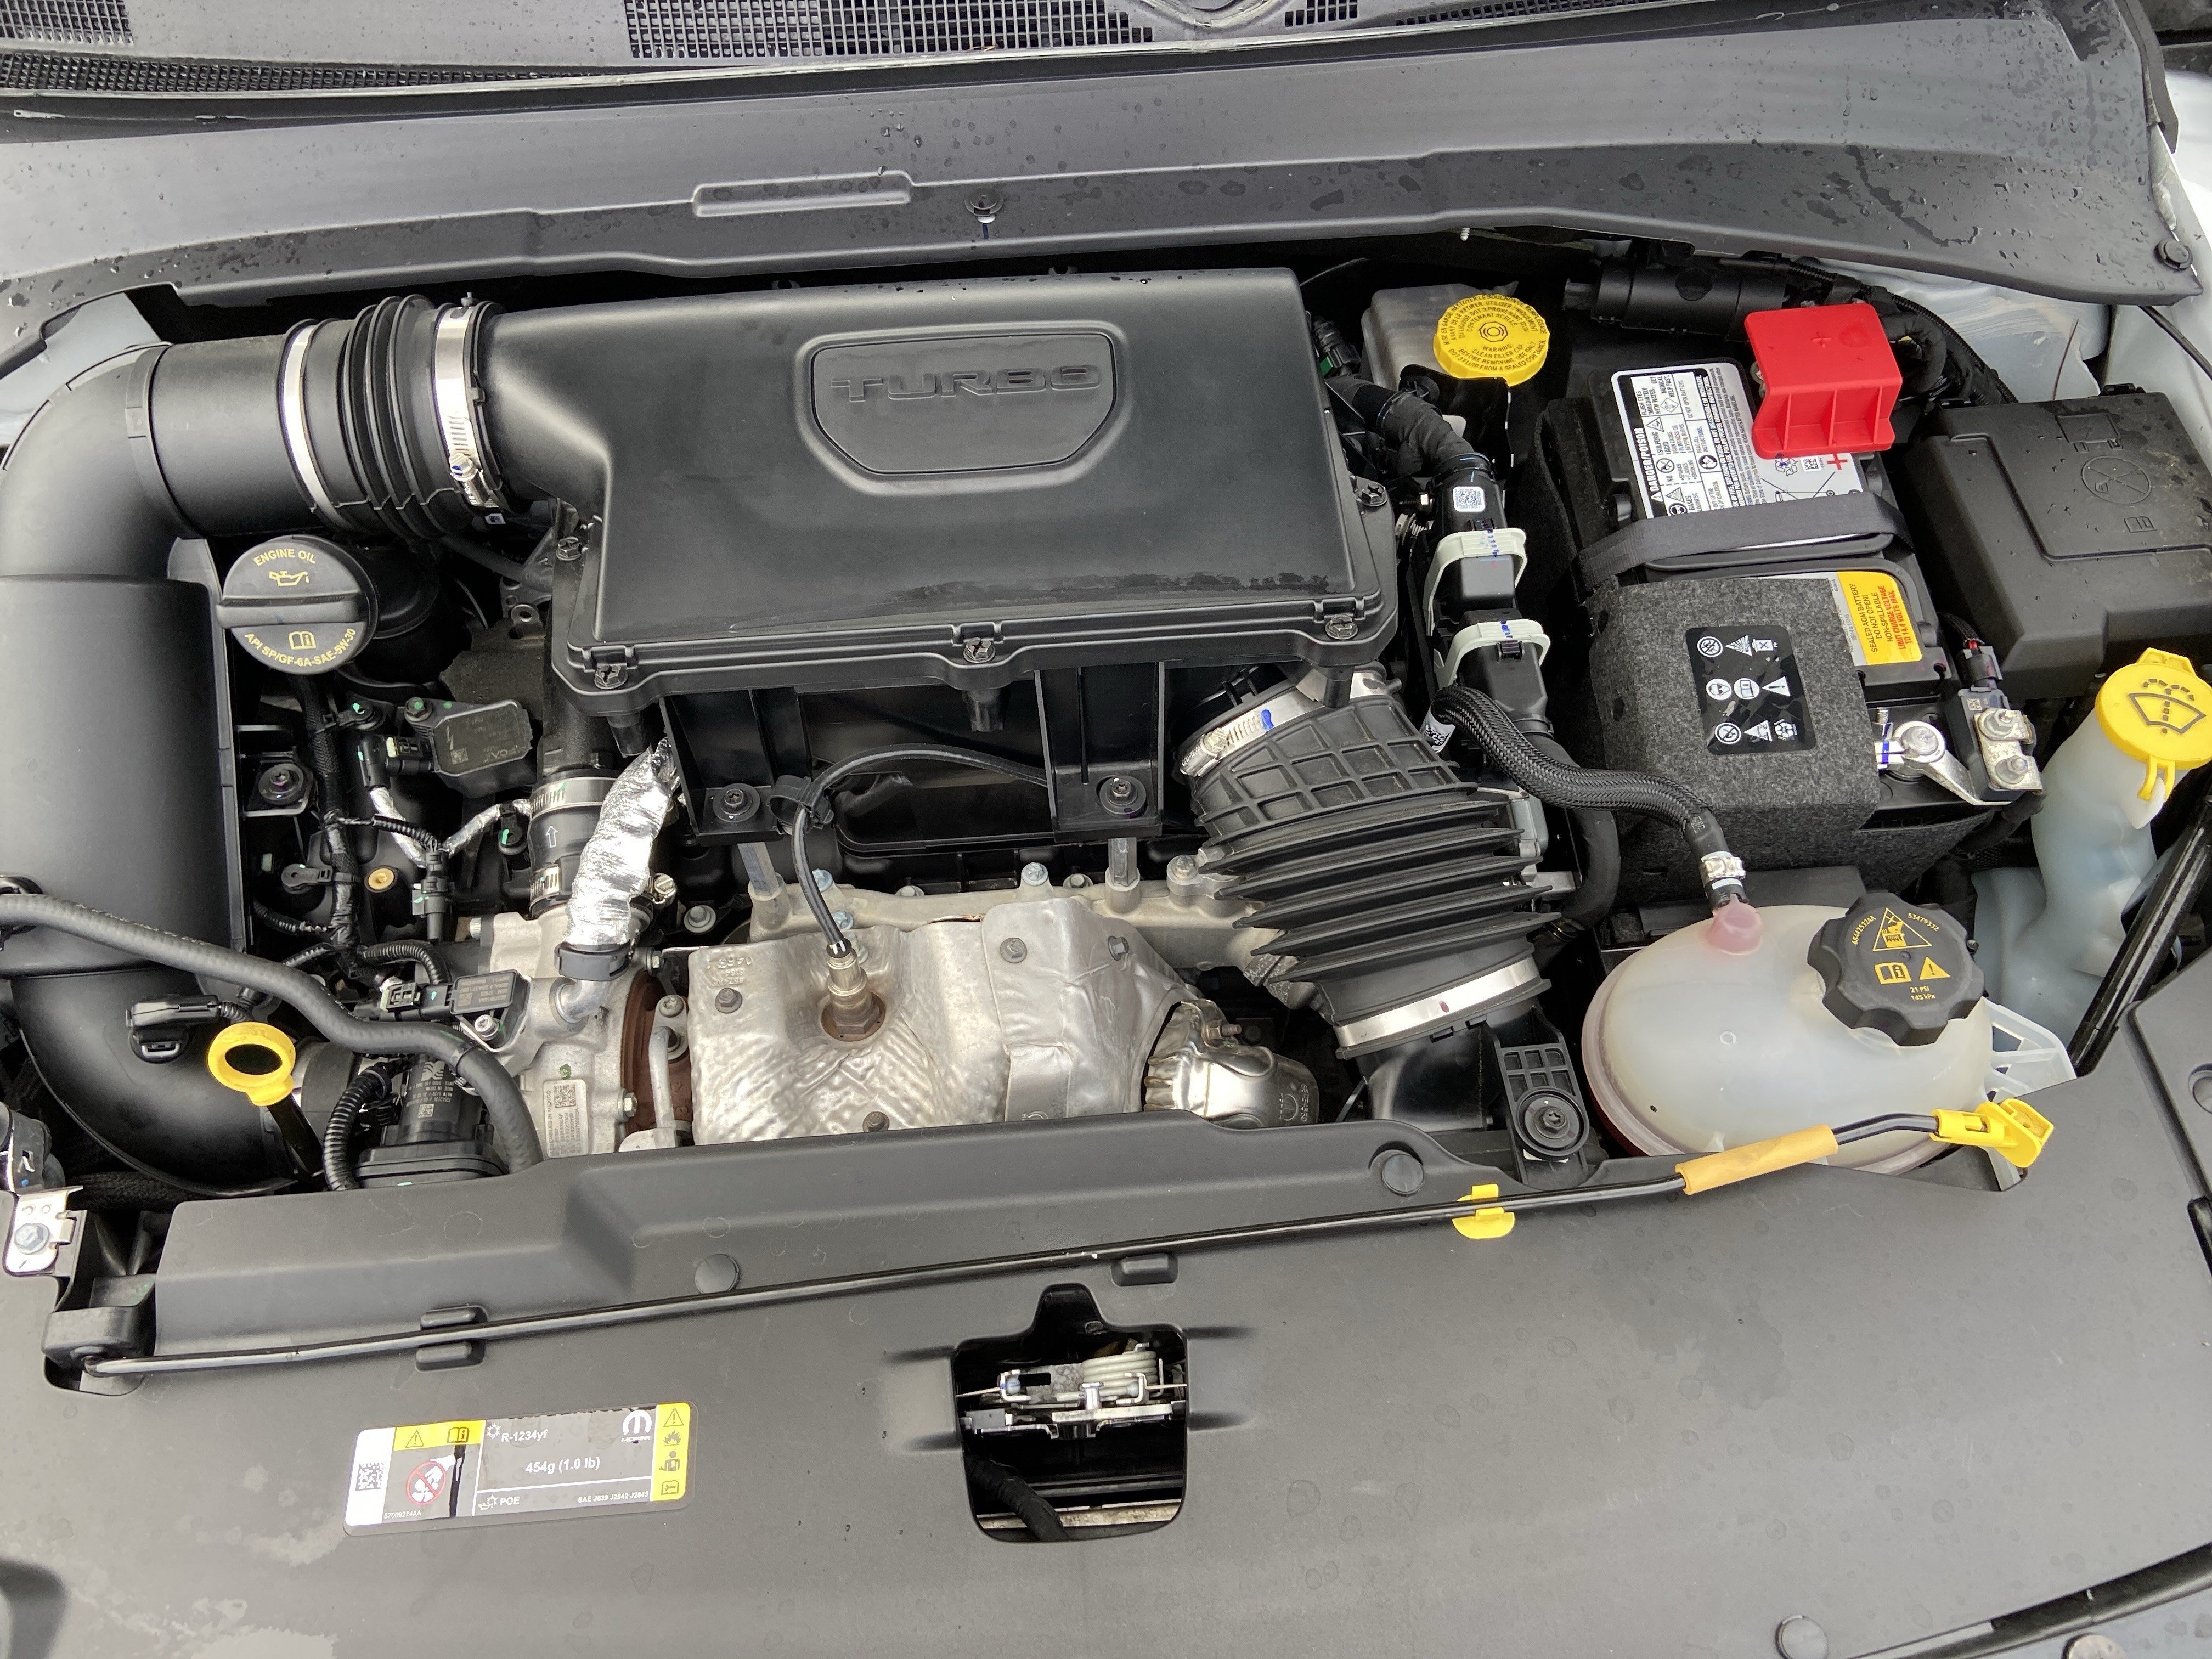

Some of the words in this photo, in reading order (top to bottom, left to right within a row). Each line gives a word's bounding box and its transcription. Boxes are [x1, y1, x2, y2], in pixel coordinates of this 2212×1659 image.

[1470, 308, 1482, 317] DOT
[1448, 348, 1460, 358] DOT
[1462, 358, 1479, 369] FLUID
[1504, 360, 1526, 371] SEALED
[1458, 348, 1481, 363] BEFORE
[1515, 352, 1525, 360] USE
[1525, 341, 1537, 353] ONLY
[1472, 348, 1493, 358] CLEAN
[1493, 351, 1513, 359] FILLER
[1514, 344, 1524, 354] CAP
[831, 364, 1101, 403] TURBO
[1657, 375, 1667, 394] MEDICAL
[1667, 386, 1675, 397] HELP
[1639, 402, 1647, 415] FLUSH
[1641, 387, 1654, 415] IMMEDIATELY
[1651, 431, 1663, 453] SULFURIC
[1662, 442, 1671, 452] ACID
[1633, 427, 1660, 492] DANGER/POISON
[1685, 495, 1695, 510] GASES
[253, 549, 295, 567] ENGINE
[297, 550, 316, 565] OIL
[1848, 583, 1864, 611] BATTERY
[1877, 585, 1892, 610] VOLTAGE
[1858, 612, 1869, 626] AGM
[1868, 616, 1878, 628] NOT
[1870, 592, 1893, 642] NON-SPILLABLE
[1886, 611, 1900, 633] CHARGE
[1892, 604, 1904, 622] VOLTS
[1873, 629, 1882, 639] DO
[1899, 623, 1909, 635] 14.4
[244, 633, 263, 650] API
[261, 628, 357, 667] SP/GF-6A-SAE-5W-30
[1864, 627, 1878, 652] SEALED
[1894, 634, 1906, 650] LIMIT
[1904, 636, 1912, 645] TO
[501, 1429, 548, 1442] R-1234yf
[525, 1460, 555, 1475] 454g
[558, 1458, 581, 1474] (1.0
[584, 1457, 600, 1470] lb)
[500, 1496, 521, 1506] POE
[630, 1491, 649, 1499] J2845
